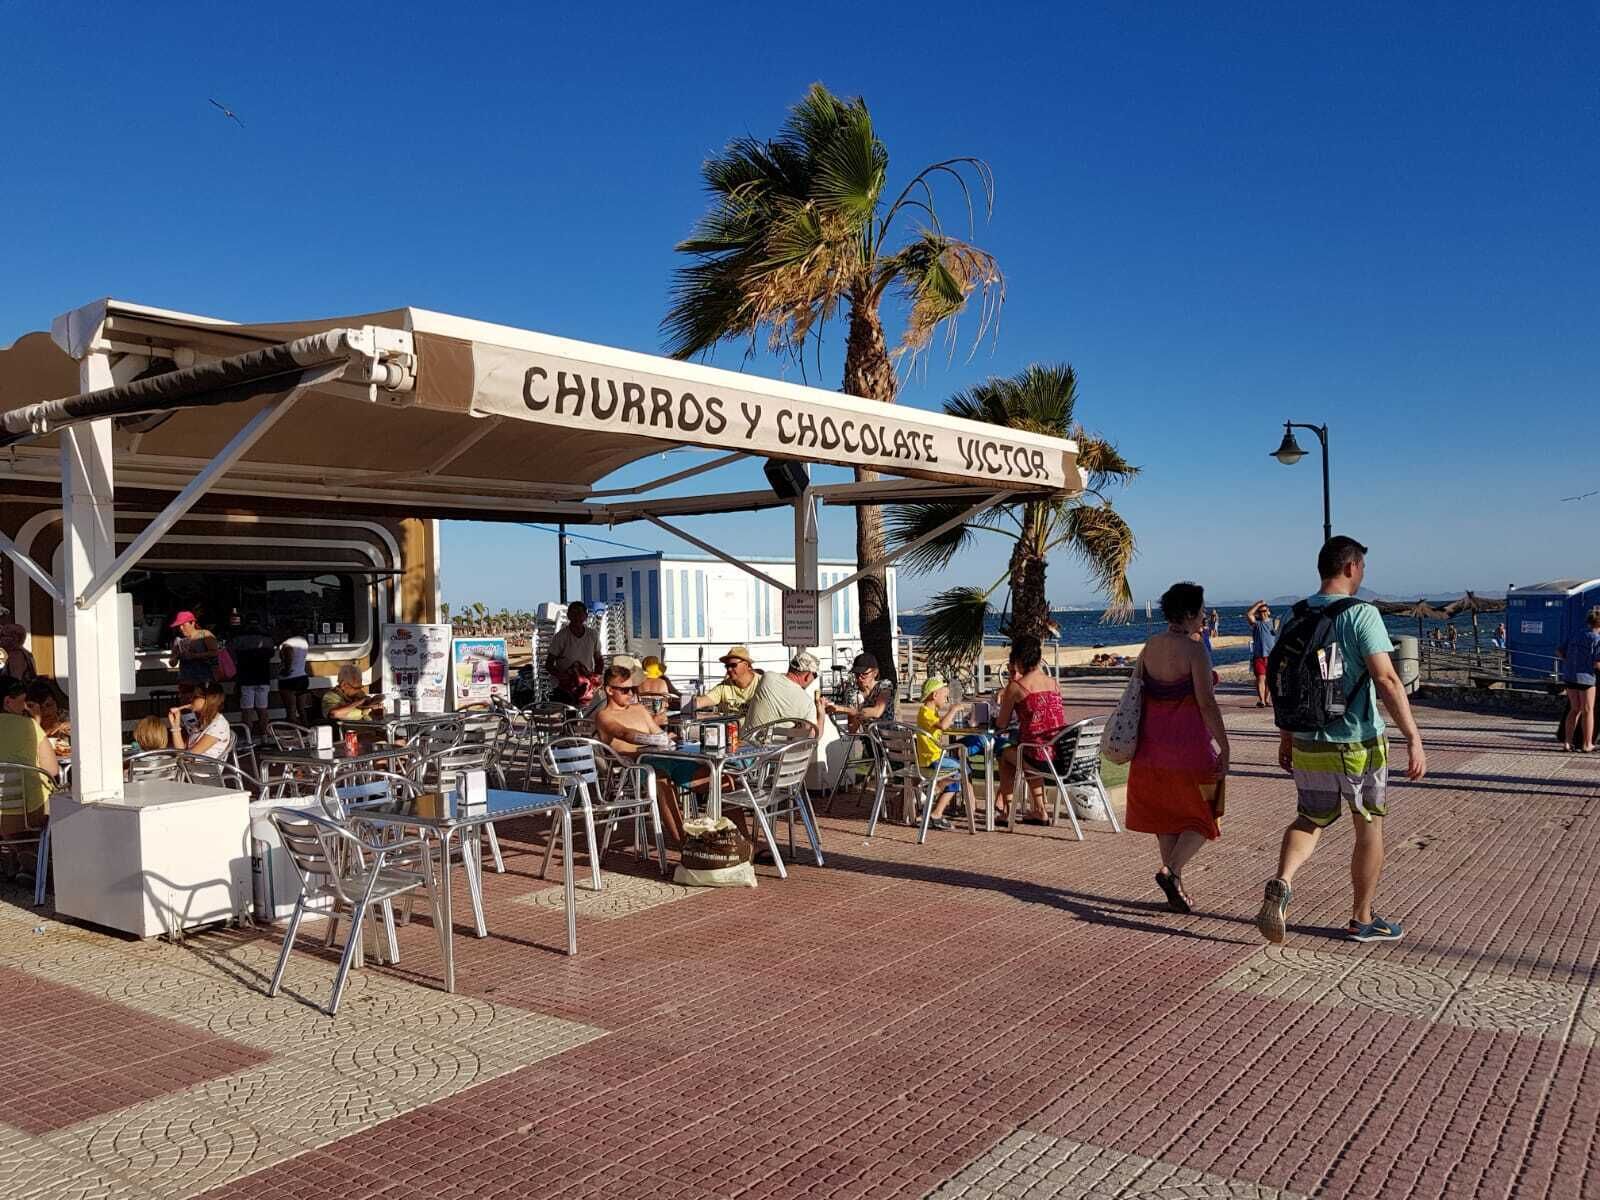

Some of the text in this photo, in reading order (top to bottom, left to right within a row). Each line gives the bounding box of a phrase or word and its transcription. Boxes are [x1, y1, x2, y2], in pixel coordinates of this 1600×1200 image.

[522, 366, 1049, 480] CHURROS Y CHOCOLATE VICTOR
